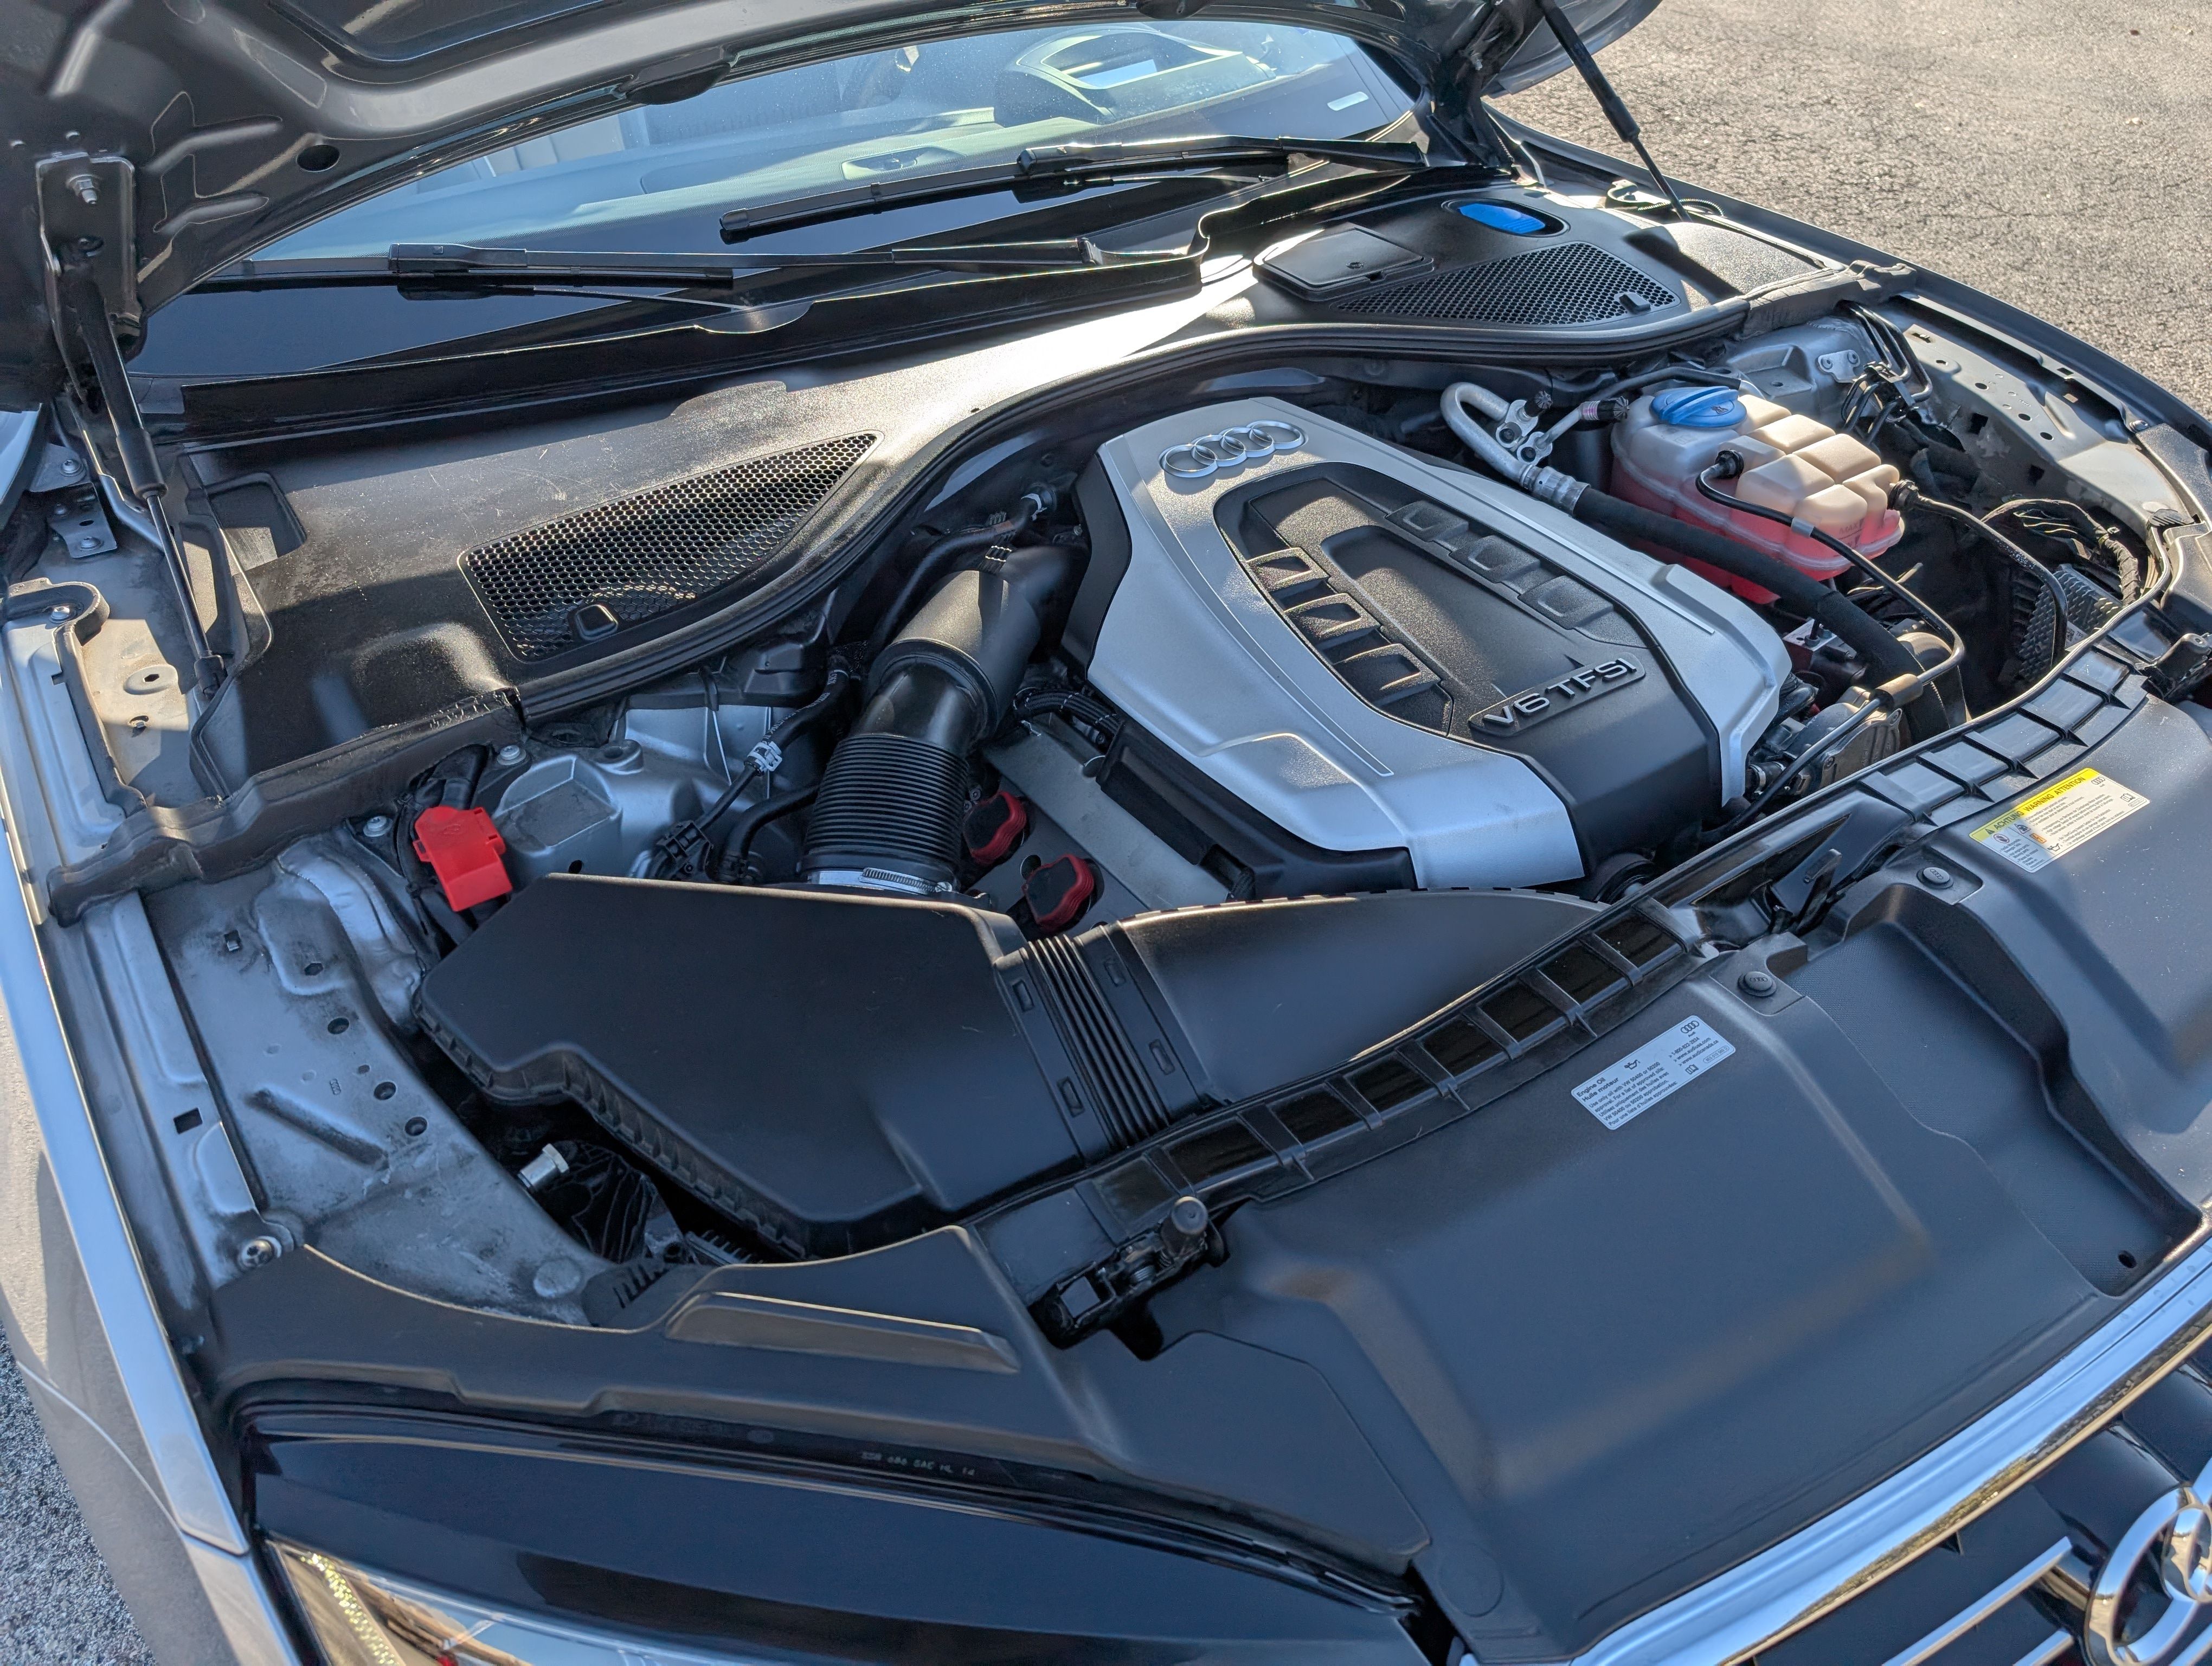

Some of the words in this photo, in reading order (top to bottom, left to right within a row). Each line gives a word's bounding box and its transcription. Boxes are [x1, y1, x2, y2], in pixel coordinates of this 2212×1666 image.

[1483, 693, 1551, 725] V6
[1545, 658, 1637, 698] TFSI
[1994, 811, 2024, 829] ACHTUNG
[2023, 794, 2054, 811] WARNING
[2054, 777, 2085, 794] ATTENTION
[1677, 1038, 1711, 1060] www.audiusa.com
[1682, 1040, 1718, 1063] www.audicanada.ca
[1577, 1084, 1597, 1097] Engine
[1582, 1092, 1597, 1101] Huile
[1598, 1078, 1618, 1092] moteur
[1595, 1099, 1613, 1112] approval.
[1637, 1072, 1655, 1086] approved
[1599, 1106, 1615, 1117] Utilisez
[1615, 1091, 1639, 1107] uniquement
[1646, 1078, 1659, 1087] huiles
[1643, 1080, 1668, 1096] approbation.
